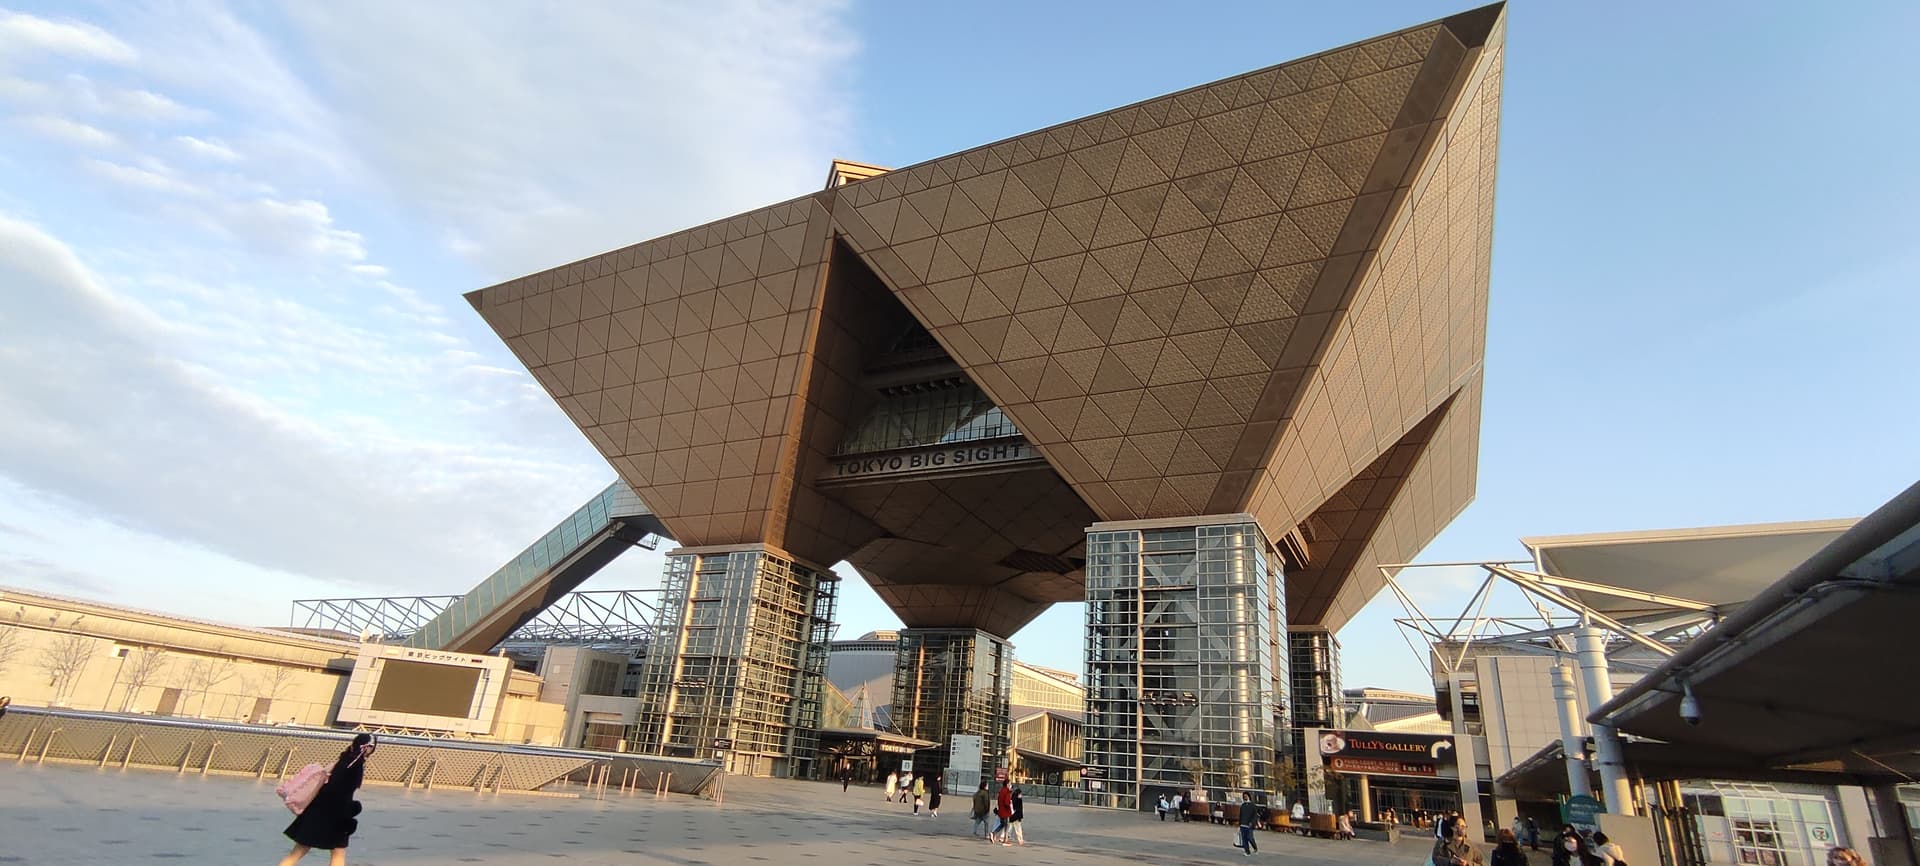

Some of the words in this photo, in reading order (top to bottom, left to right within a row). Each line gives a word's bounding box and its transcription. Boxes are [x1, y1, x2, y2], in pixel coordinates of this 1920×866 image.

[836, 456, 903, 475] TOKYO
[910, 452, 946, 468] BIG
[953, 443, 1024, 463] SIGHT
[1385, 743, 1426, 752] GALLERY
